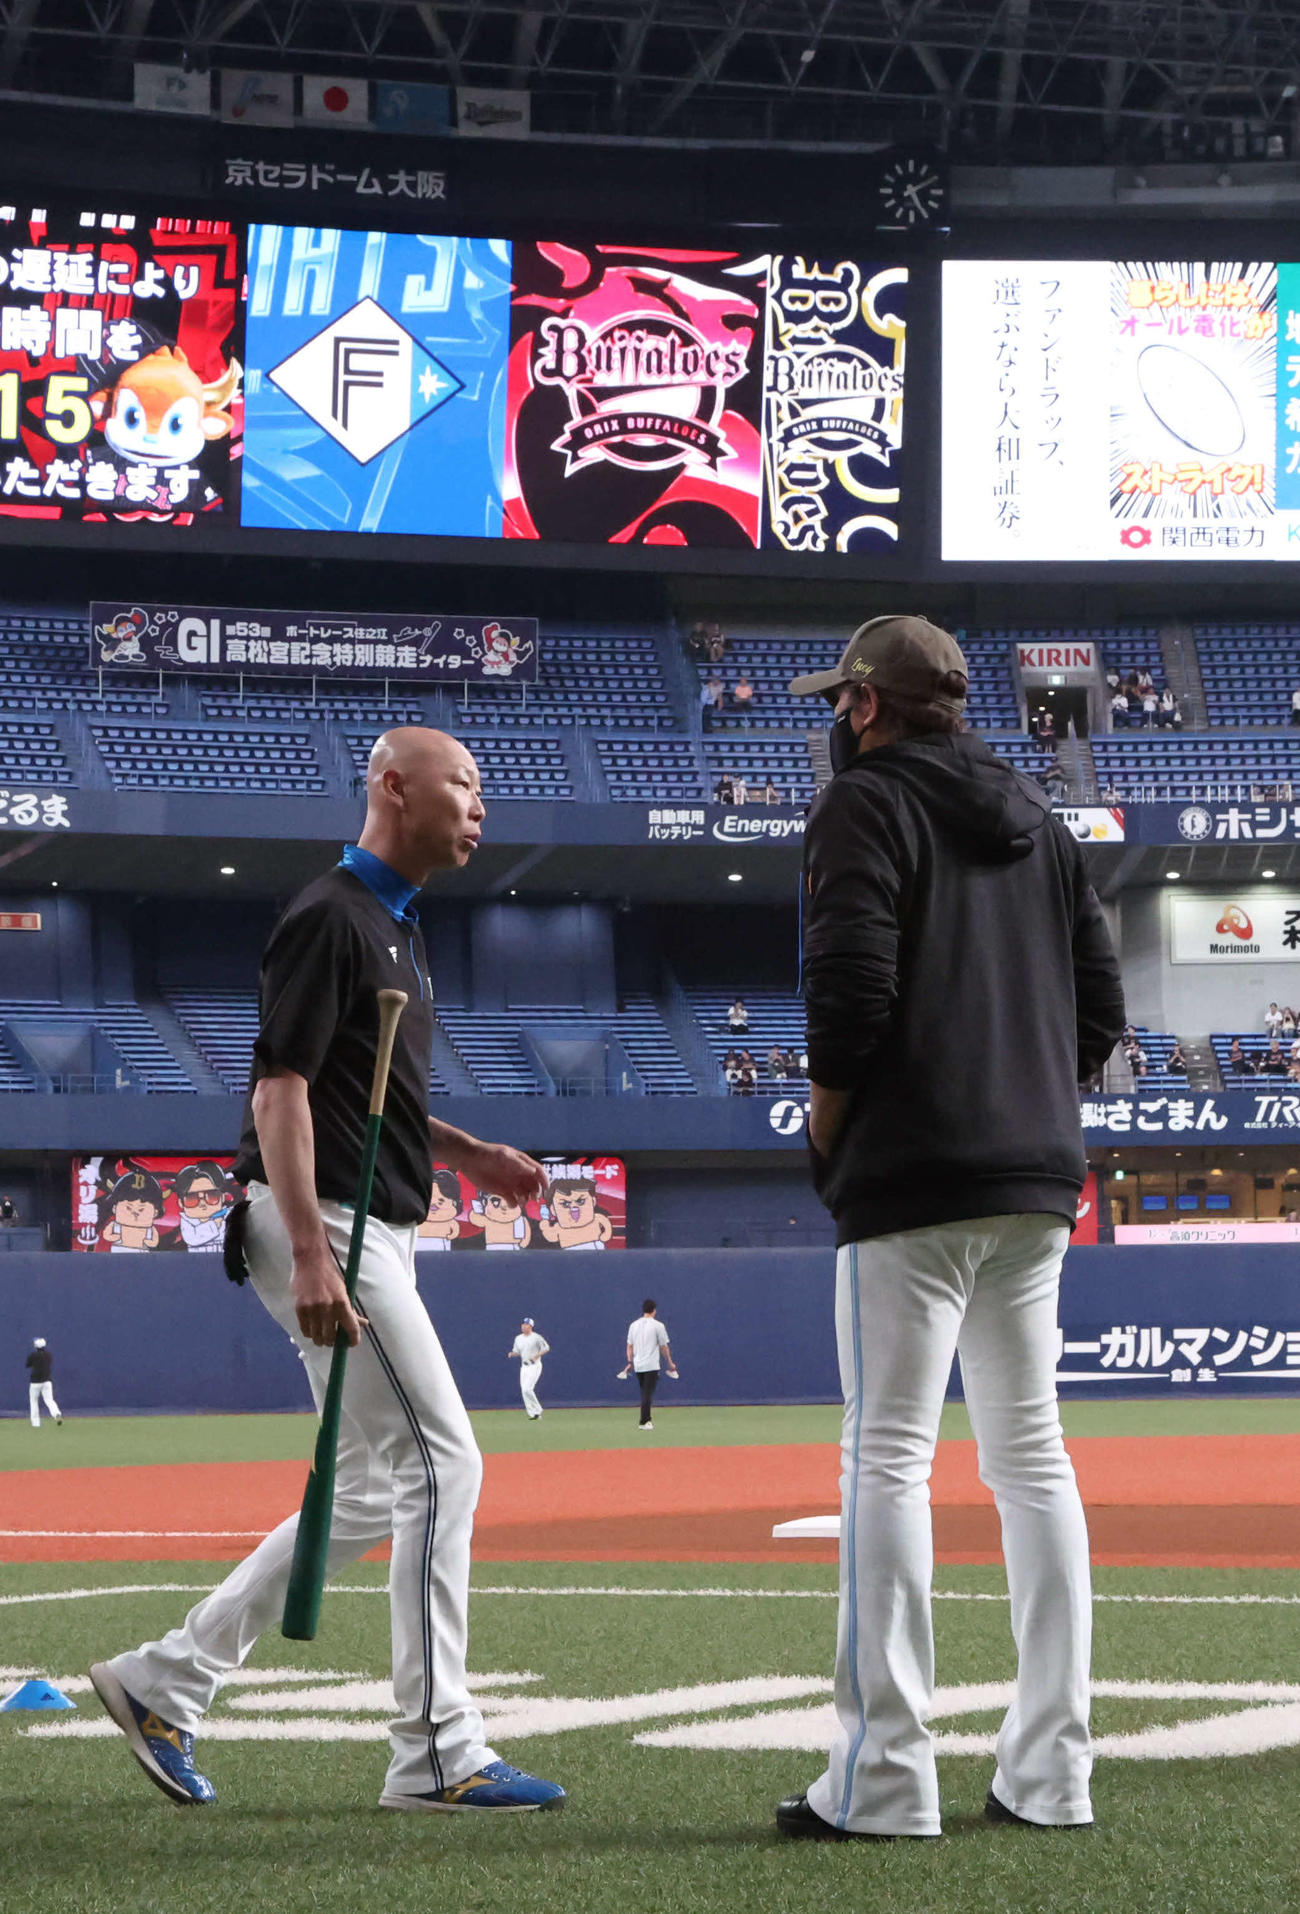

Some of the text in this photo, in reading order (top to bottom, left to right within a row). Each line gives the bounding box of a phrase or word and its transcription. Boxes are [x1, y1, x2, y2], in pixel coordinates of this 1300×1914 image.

[224, 157, 446, 200] 京セラドーム大阪
[0, 248, 199, 300] 遅延により
[1119, 311, 1272, 340] オール電化が
[536, 317, 748, 386] Buffaloes
[766, 354, 904, 395] Buffaloes
[584, 416, 708, 445] ORIX BUFFALOES
[792, 417, 880, 440] ORIX BUFFALOES
[1119, 461, 1265, 495] ストライク!
[1162, 526, 1265, 548] 関西電力
[1019, 648, 1091, 667] KIRIN
[648, 809, 705, 825] 自動車用
[648, 825, 705, 840] バッテリー
[1210, 943, 1260, 954] Morimoto
[1171, 1367, 1218, 1382] 創生
